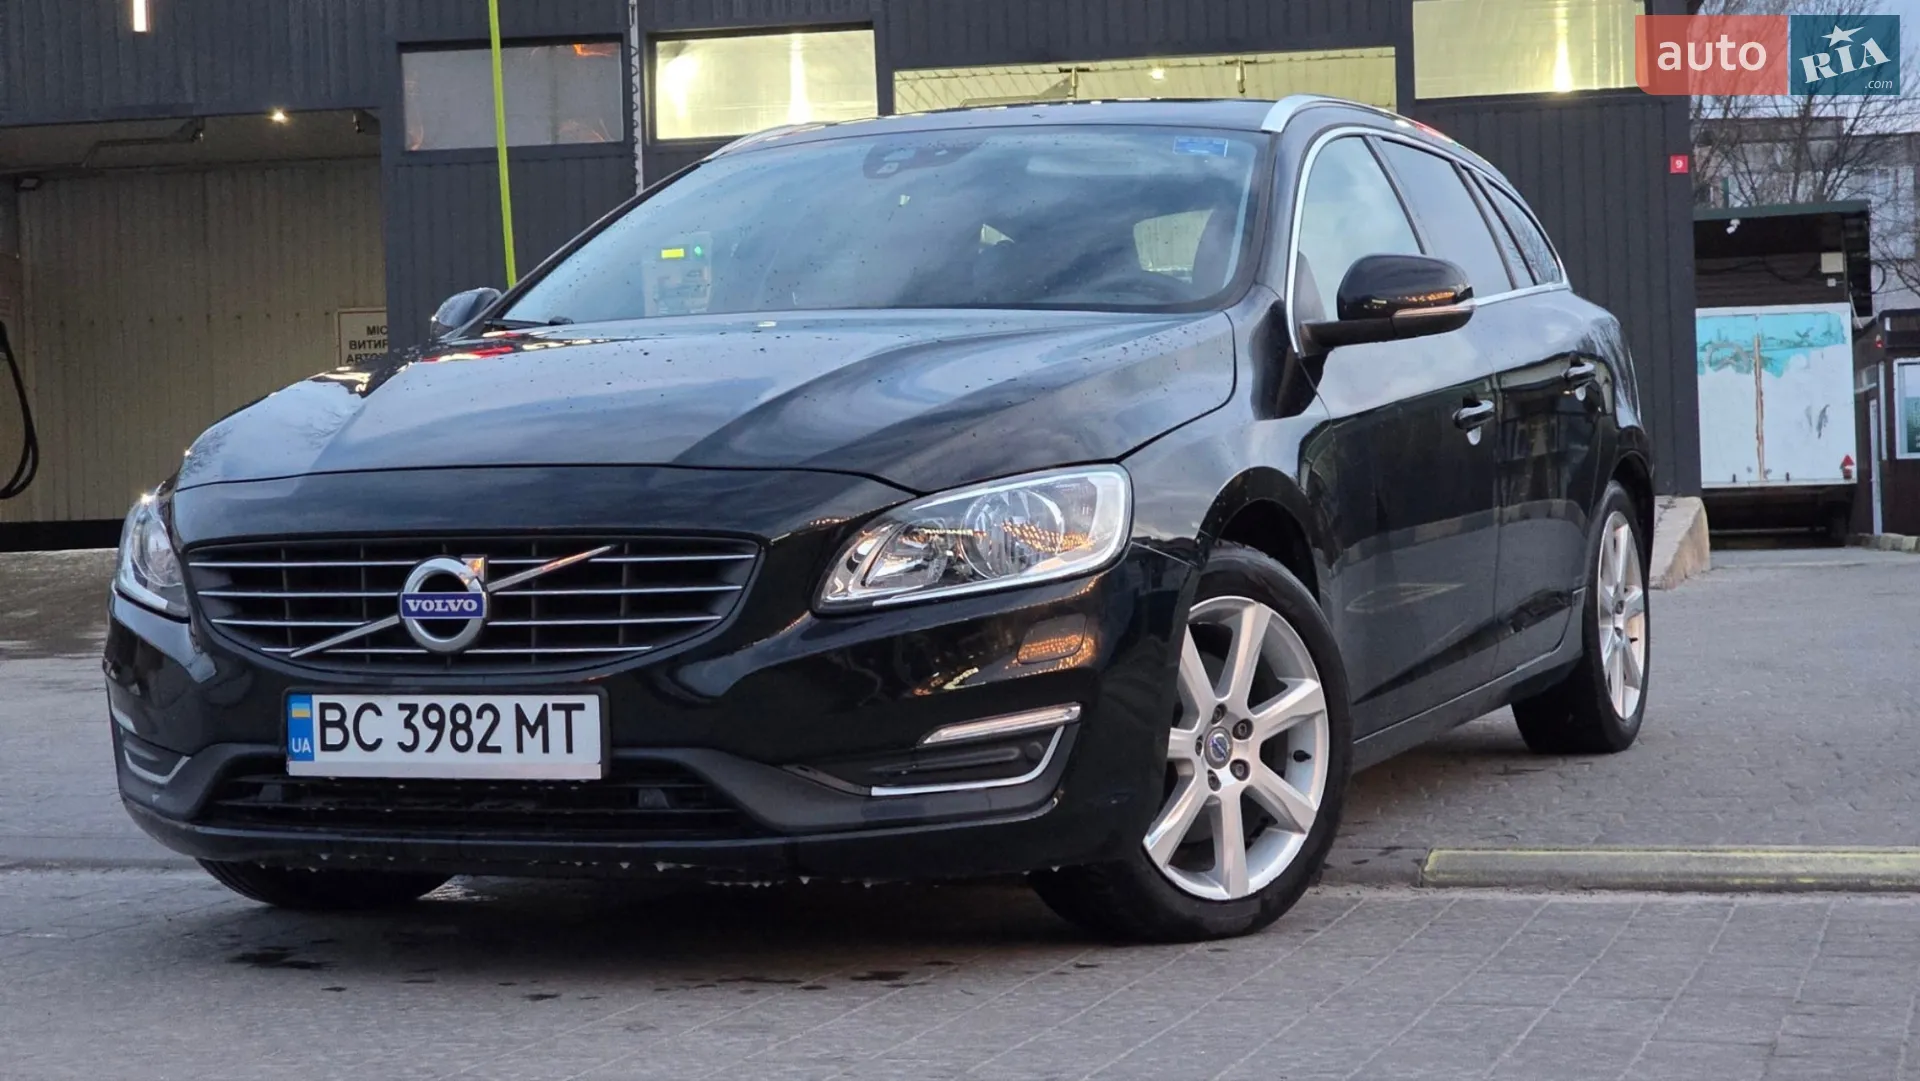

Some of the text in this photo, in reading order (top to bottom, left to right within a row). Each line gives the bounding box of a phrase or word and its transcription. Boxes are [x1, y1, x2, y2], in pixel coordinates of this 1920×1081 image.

[1675, 159, 1684, 169] 9
[405, 599, 478, 612] VOLVO
[318, 702, 586, 754] BC 3982 MT
[292, 738, 312, 753] UA
